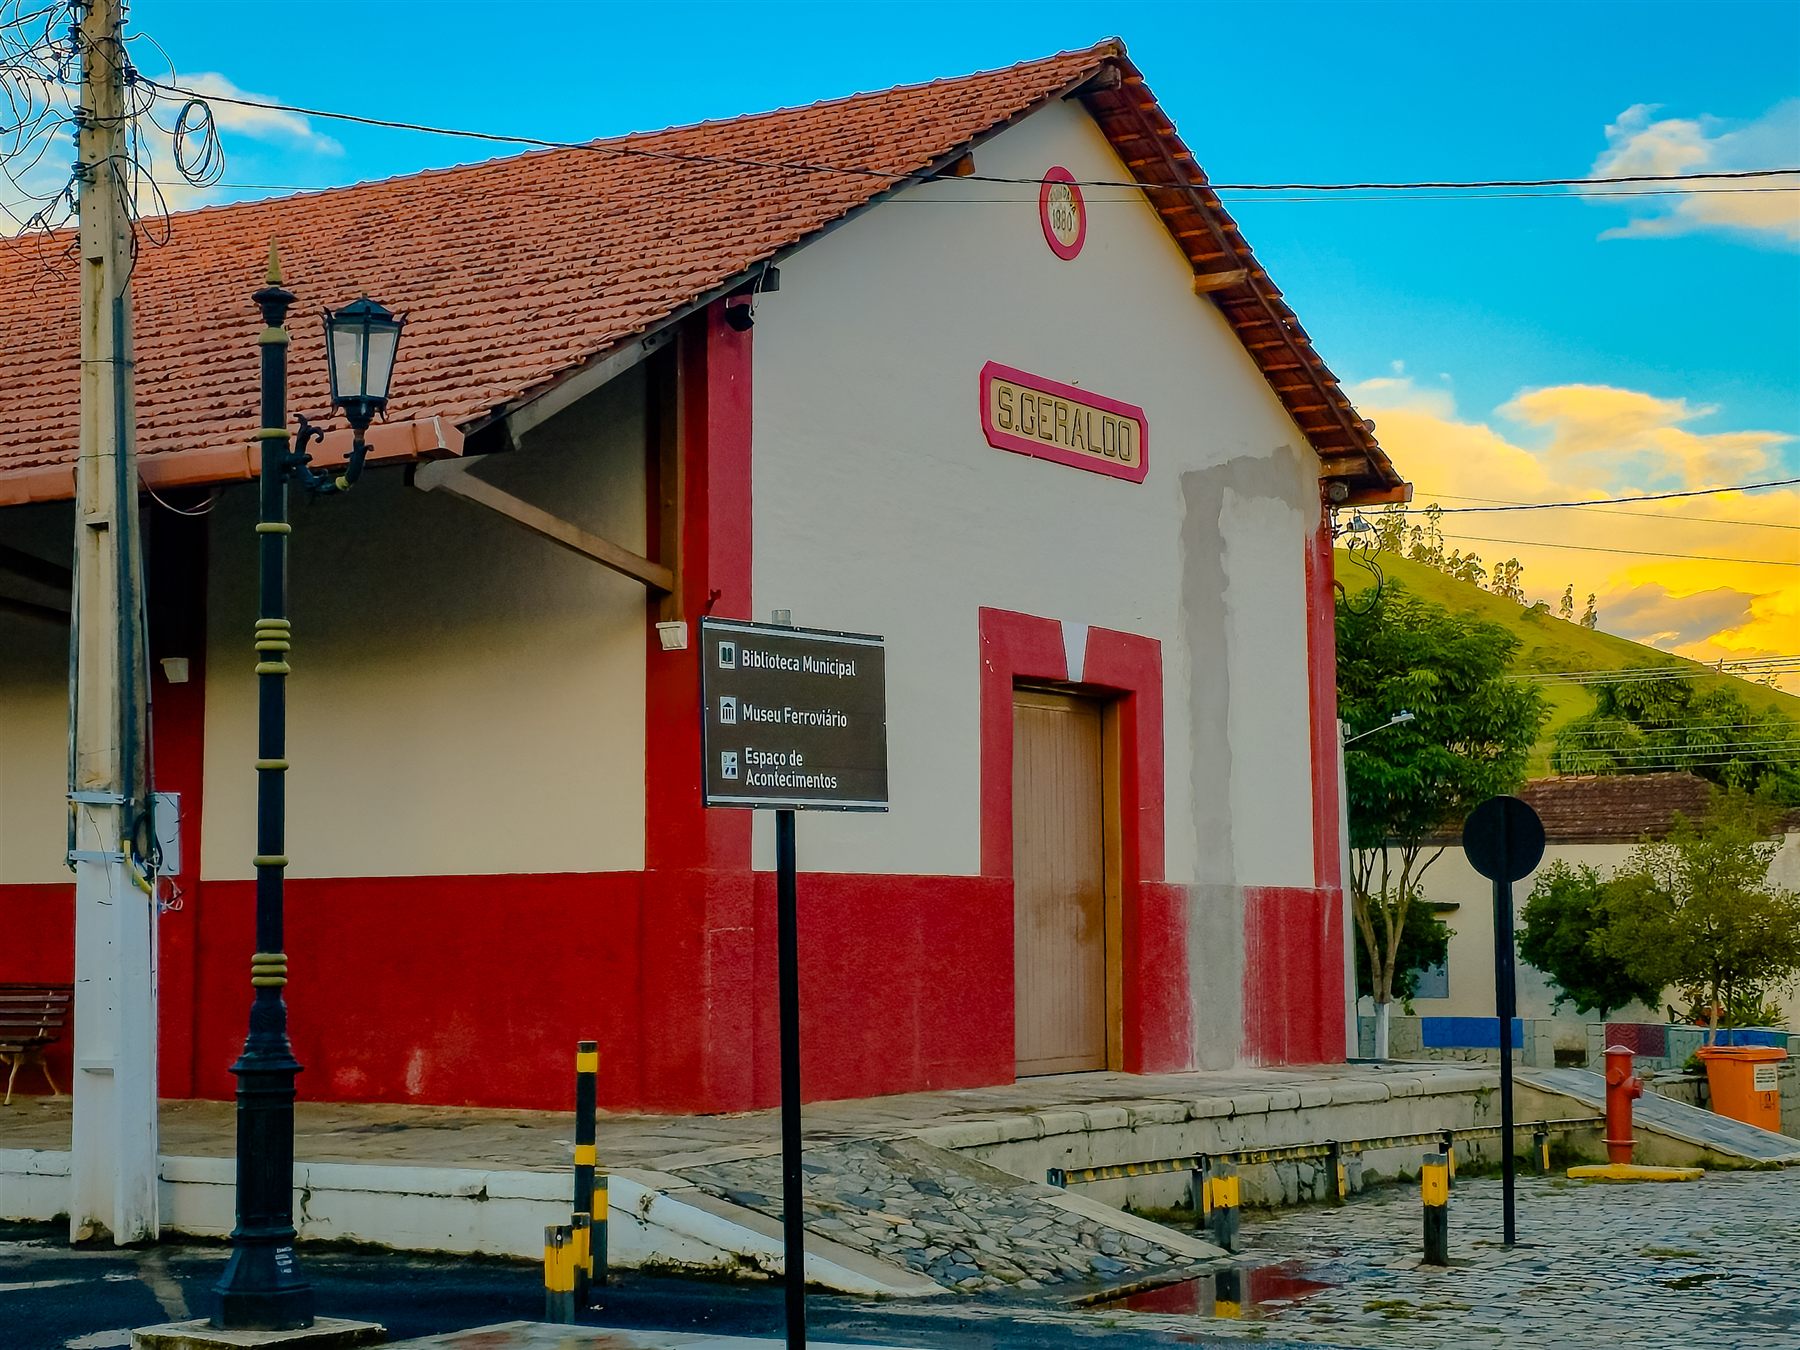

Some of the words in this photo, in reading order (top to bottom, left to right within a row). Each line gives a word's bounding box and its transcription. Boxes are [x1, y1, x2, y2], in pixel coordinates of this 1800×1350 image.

[742, 649, 800, 672] Biblioteca
[803, 655, 856, 679] Municipal
[743, 703, 781, 724] Museu
[784, 707, 848, 728] Ferroviário
[745, 747, 786, 770] Espaço
[789, 749, 804, 767] de
[745, 769, 838, 789] Acontecimentos
